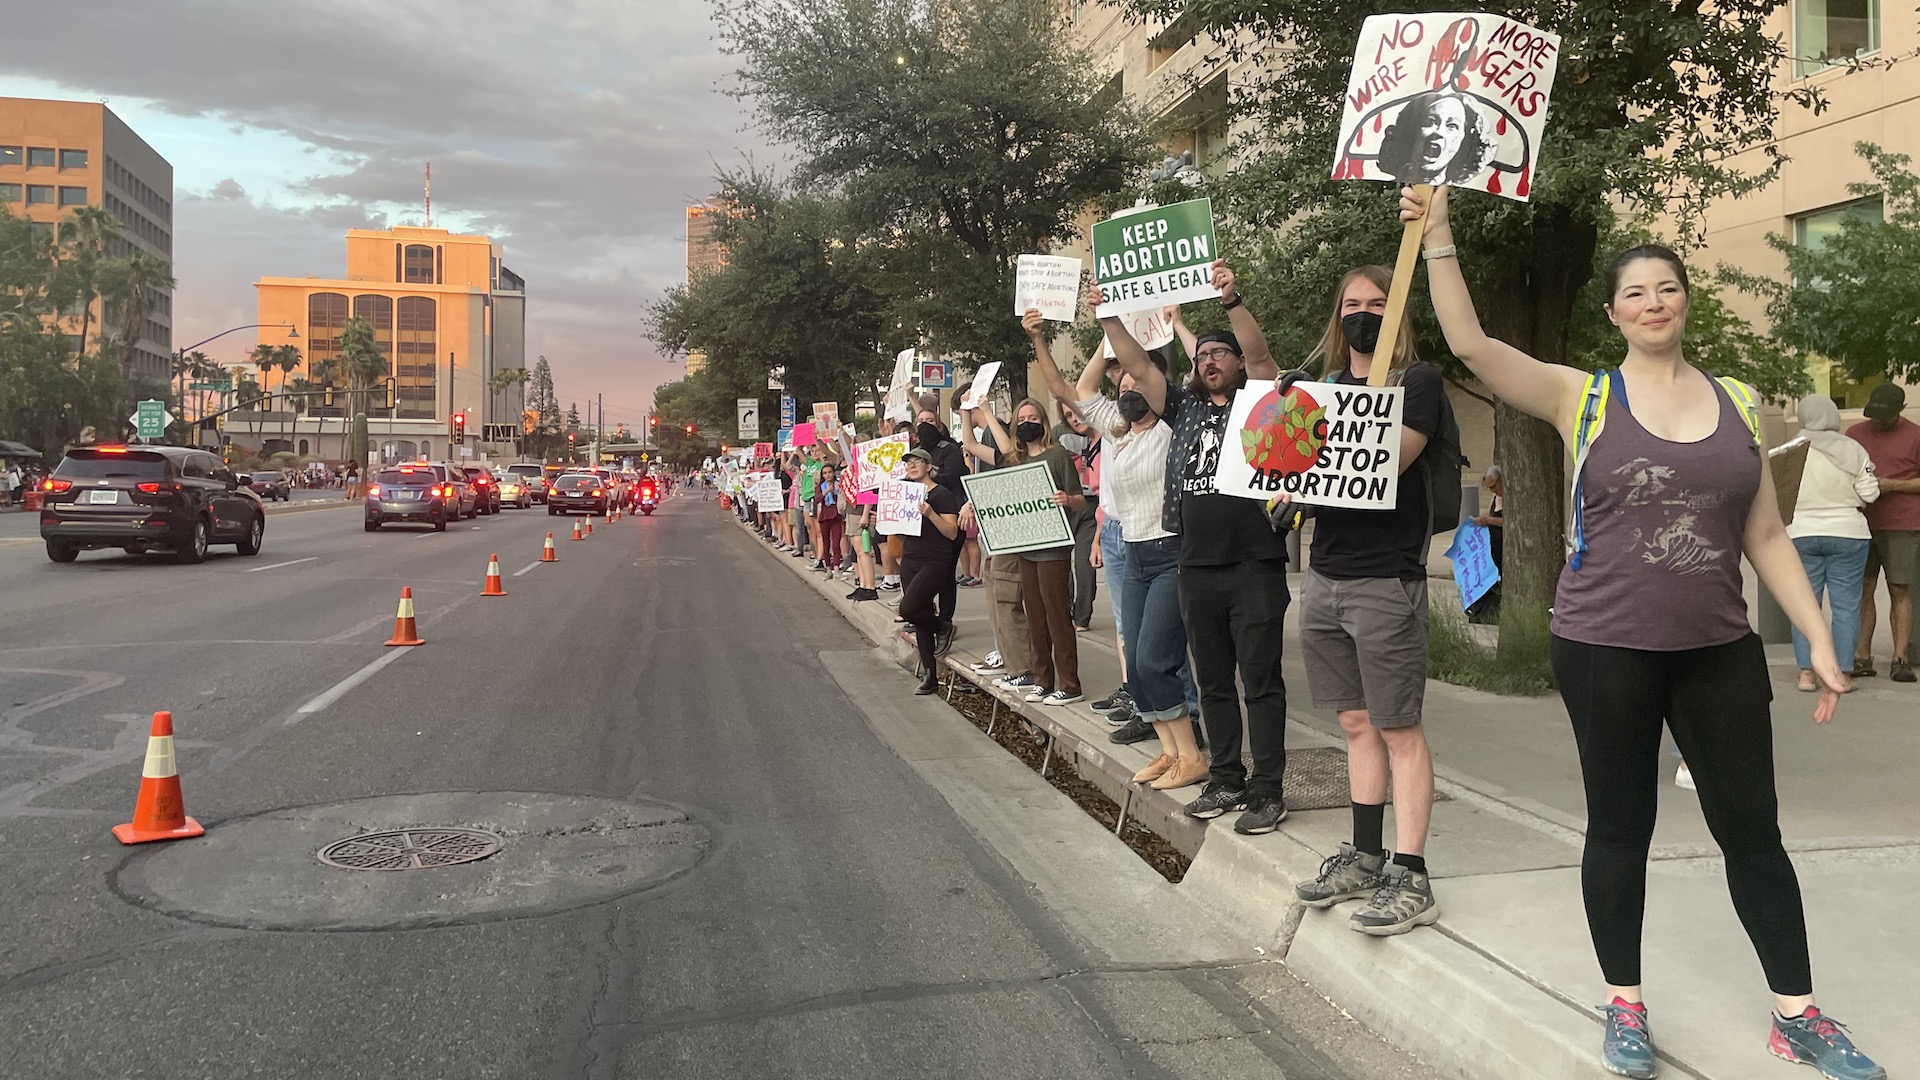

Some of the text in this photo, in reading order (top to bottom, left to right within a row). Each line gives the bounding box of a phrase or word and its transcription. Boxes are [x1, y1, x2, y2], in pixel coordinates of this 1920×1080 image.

[1374, 19, 1557, 70] NO MORE
[1348, 43, 1546, 118] WIRE HANGERS
[1121, 218, 1169, 247] KEEP
[1098, 234, 1210, 280] ABORTION
[1030, 269, 1045, 277] STOP
[1102, 267, 1212, 304] SAFE & LEGAL
[1031, 281, 1046, 291] SAFE
[1133, 312, 1174, 347] GAL
[1335, 390, 1395, 418] YOU
[142, 417, 159, 428] 25
[1312, 418, 1393, 444] CAN'T
[856, 440, 882, 458] KEEP
[1315, 445, 1391, 474] STOP
[860, 468, 907, 487] MY BOD
[881, 481, 903, 498] HER
[969, 469, 1047, 494] PROCHOICE
[1248, 467, 1389, 501] ABORTION
[972, 483, 1051, 507] PROCHOICE
[878, 501, 921, 521] HER choice
[978, 497, 1057, 521] PROCHOICE
[983, 509, 1061, 532] PROCHOICE
[988, 522, 1067, 547] PROCHOICE
